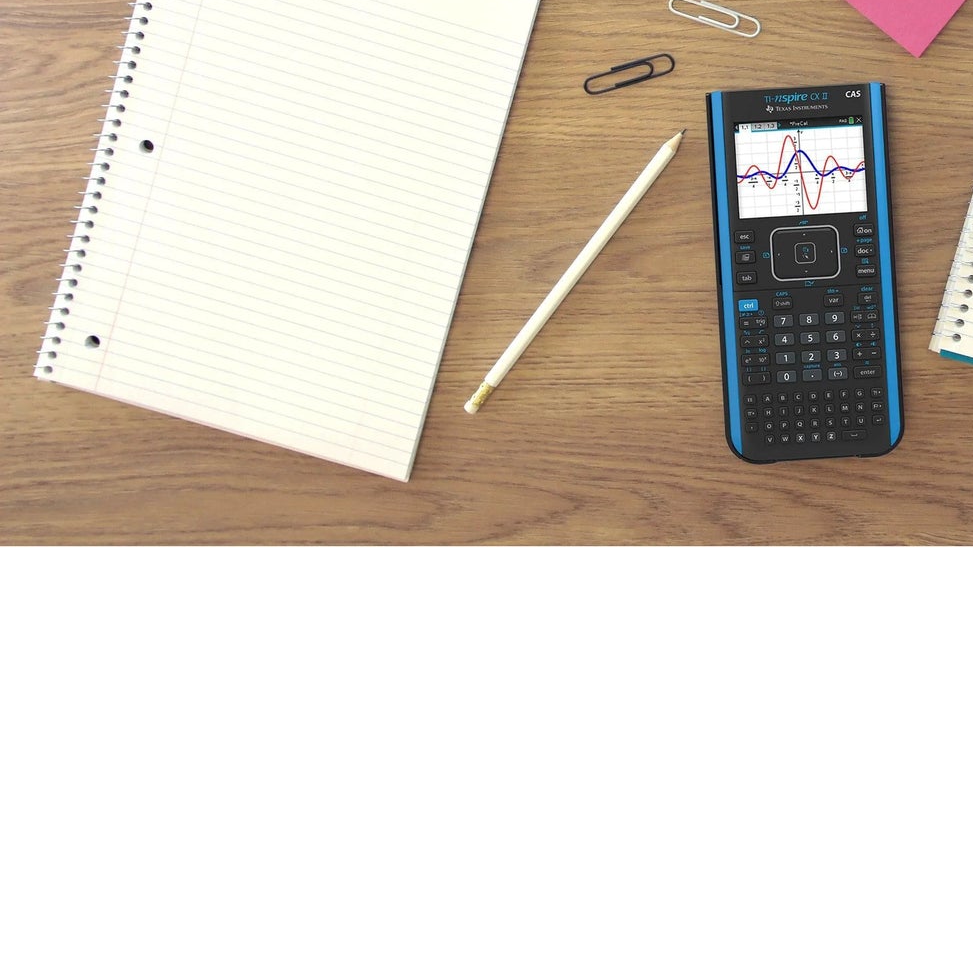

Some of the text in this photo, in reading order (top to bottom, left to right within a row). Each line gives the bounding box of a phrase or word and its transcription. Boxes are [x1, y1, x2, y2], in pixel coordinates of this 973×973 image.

[764, 92, 829, 105] TI-nspire CX II
[845, 90, 861, 99] CAS
[792, 103, 829, 111] INSTRUMENTS
[806, 316, 813, 324] 8
[831, 314, 838, 323] 9
[781, 336, 788, 344] 4
[808, 353, 815, 361] 2
[833, 351, 840, 360] 3
